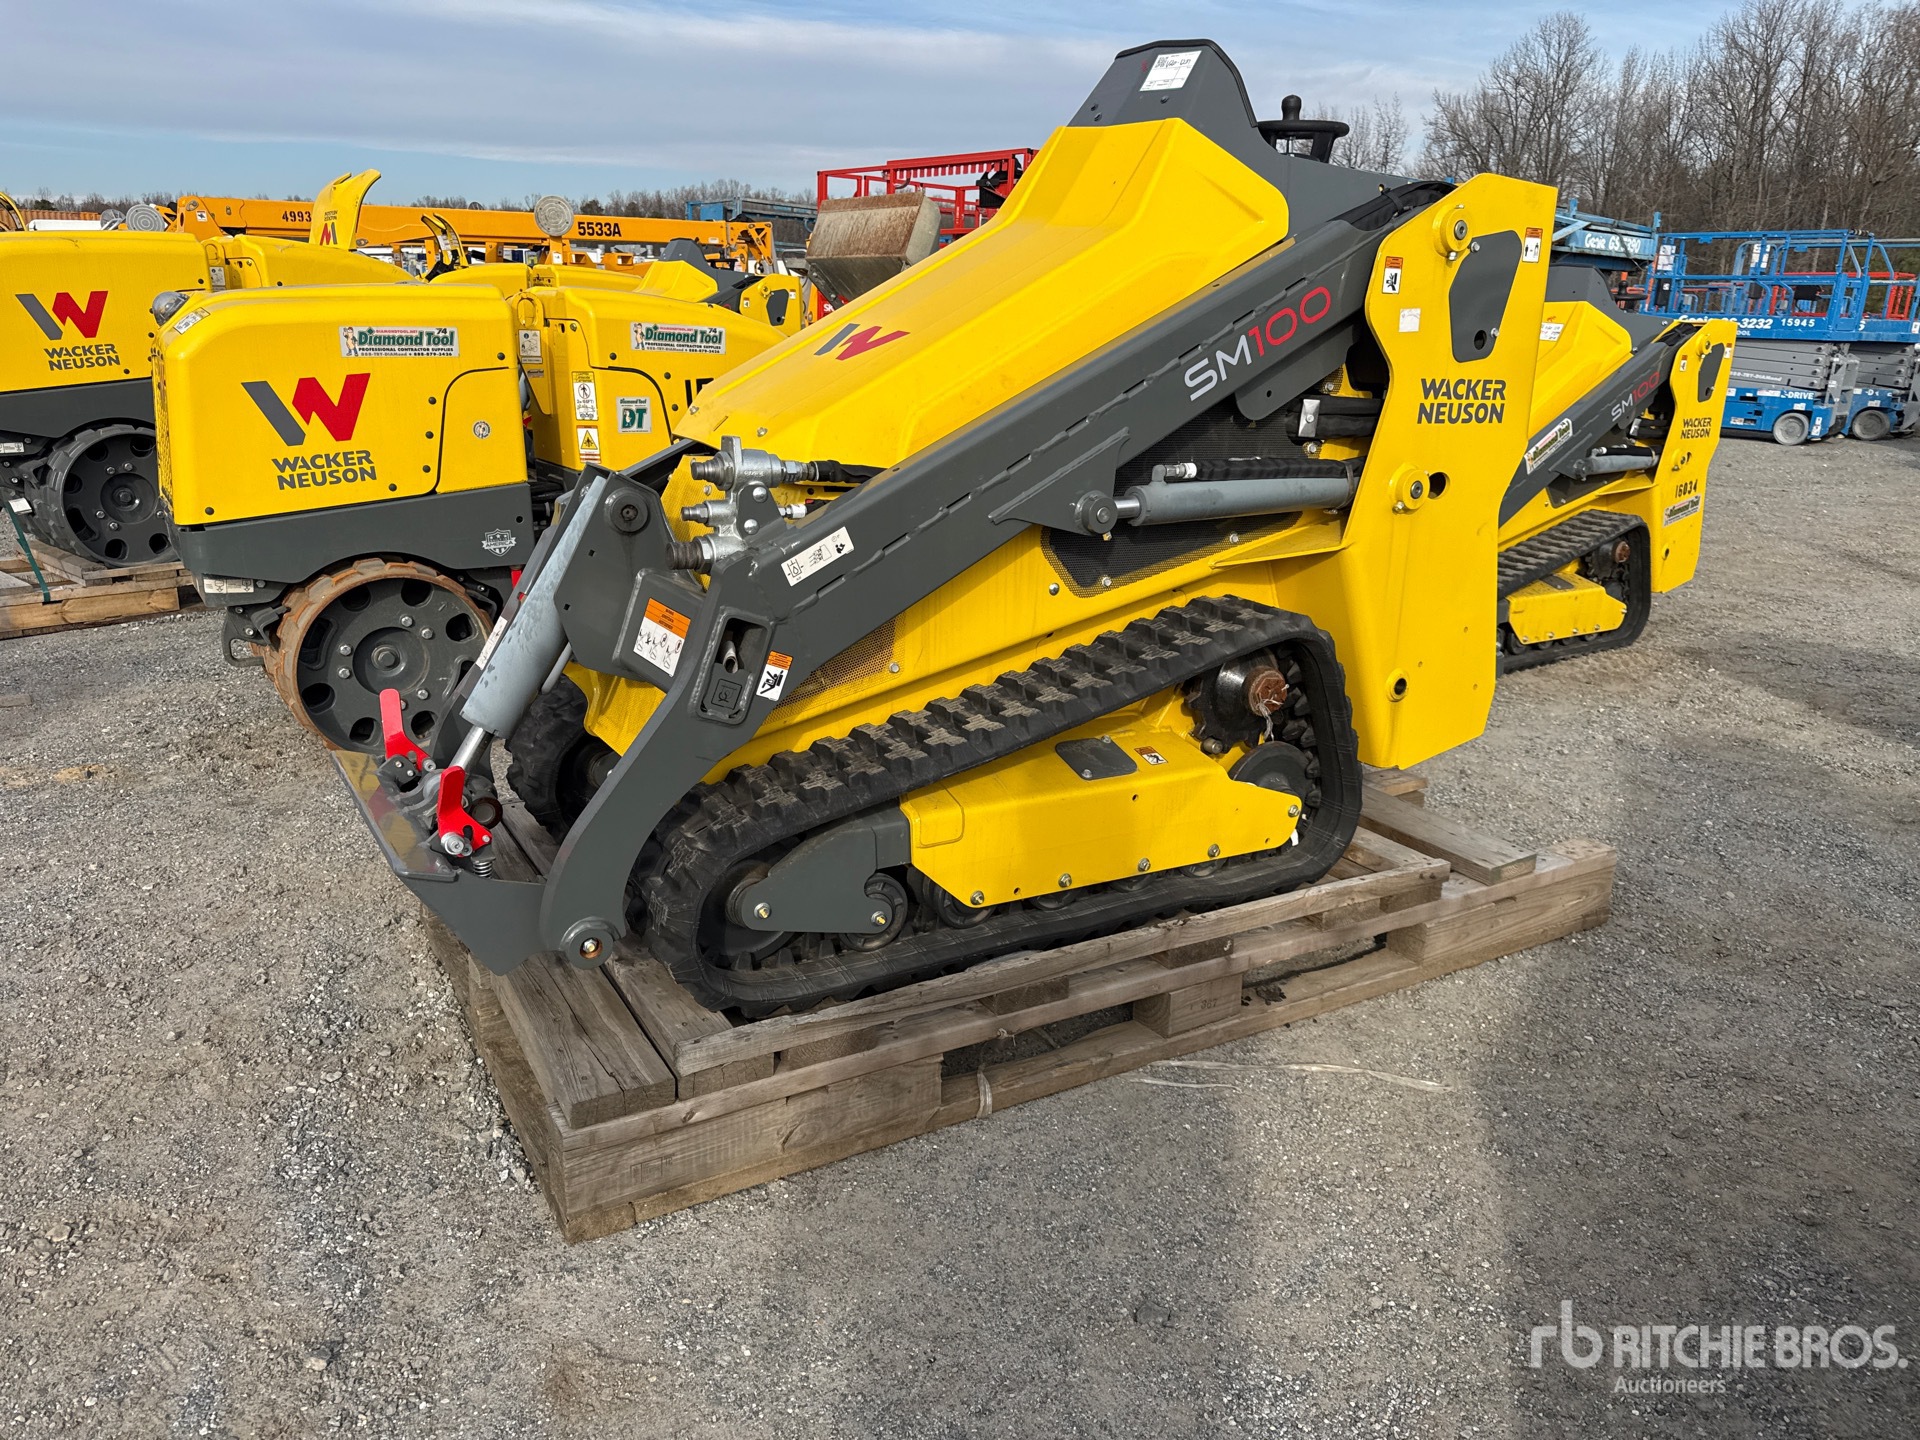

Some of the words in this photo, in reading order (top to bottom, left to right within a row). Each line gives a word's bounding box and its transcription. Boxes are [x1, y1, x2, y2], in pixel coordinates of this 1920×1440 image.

[577, 221, 622, 238] 5533A
[1780, 318, 1815, 328] 15945
[357, 328, 424, 347] Diamond
[425, 330, 455, 347] Tool
[645, 324, 698, 343] Diamond
[700, 329, 722, 344] Tool
[1184, 286, 1332, 402] SM100
[43, 343, 118, 359] WACKER
[48, 355, 121, 371] NEUSON
[1420, 378, 1507, 400] WACKER
[1611, 371, 1660, 422] SM100
[621, 408, 648, 429] DT
[1416, 402, 1505, 424] NEUSON
[1682, 417, 1712, 428] WACKER
[1680, 428, 1711, 439] NEUSON
[271, 449, 374, 473] WACKER
[277, 465, 377, 490] NEUSON
